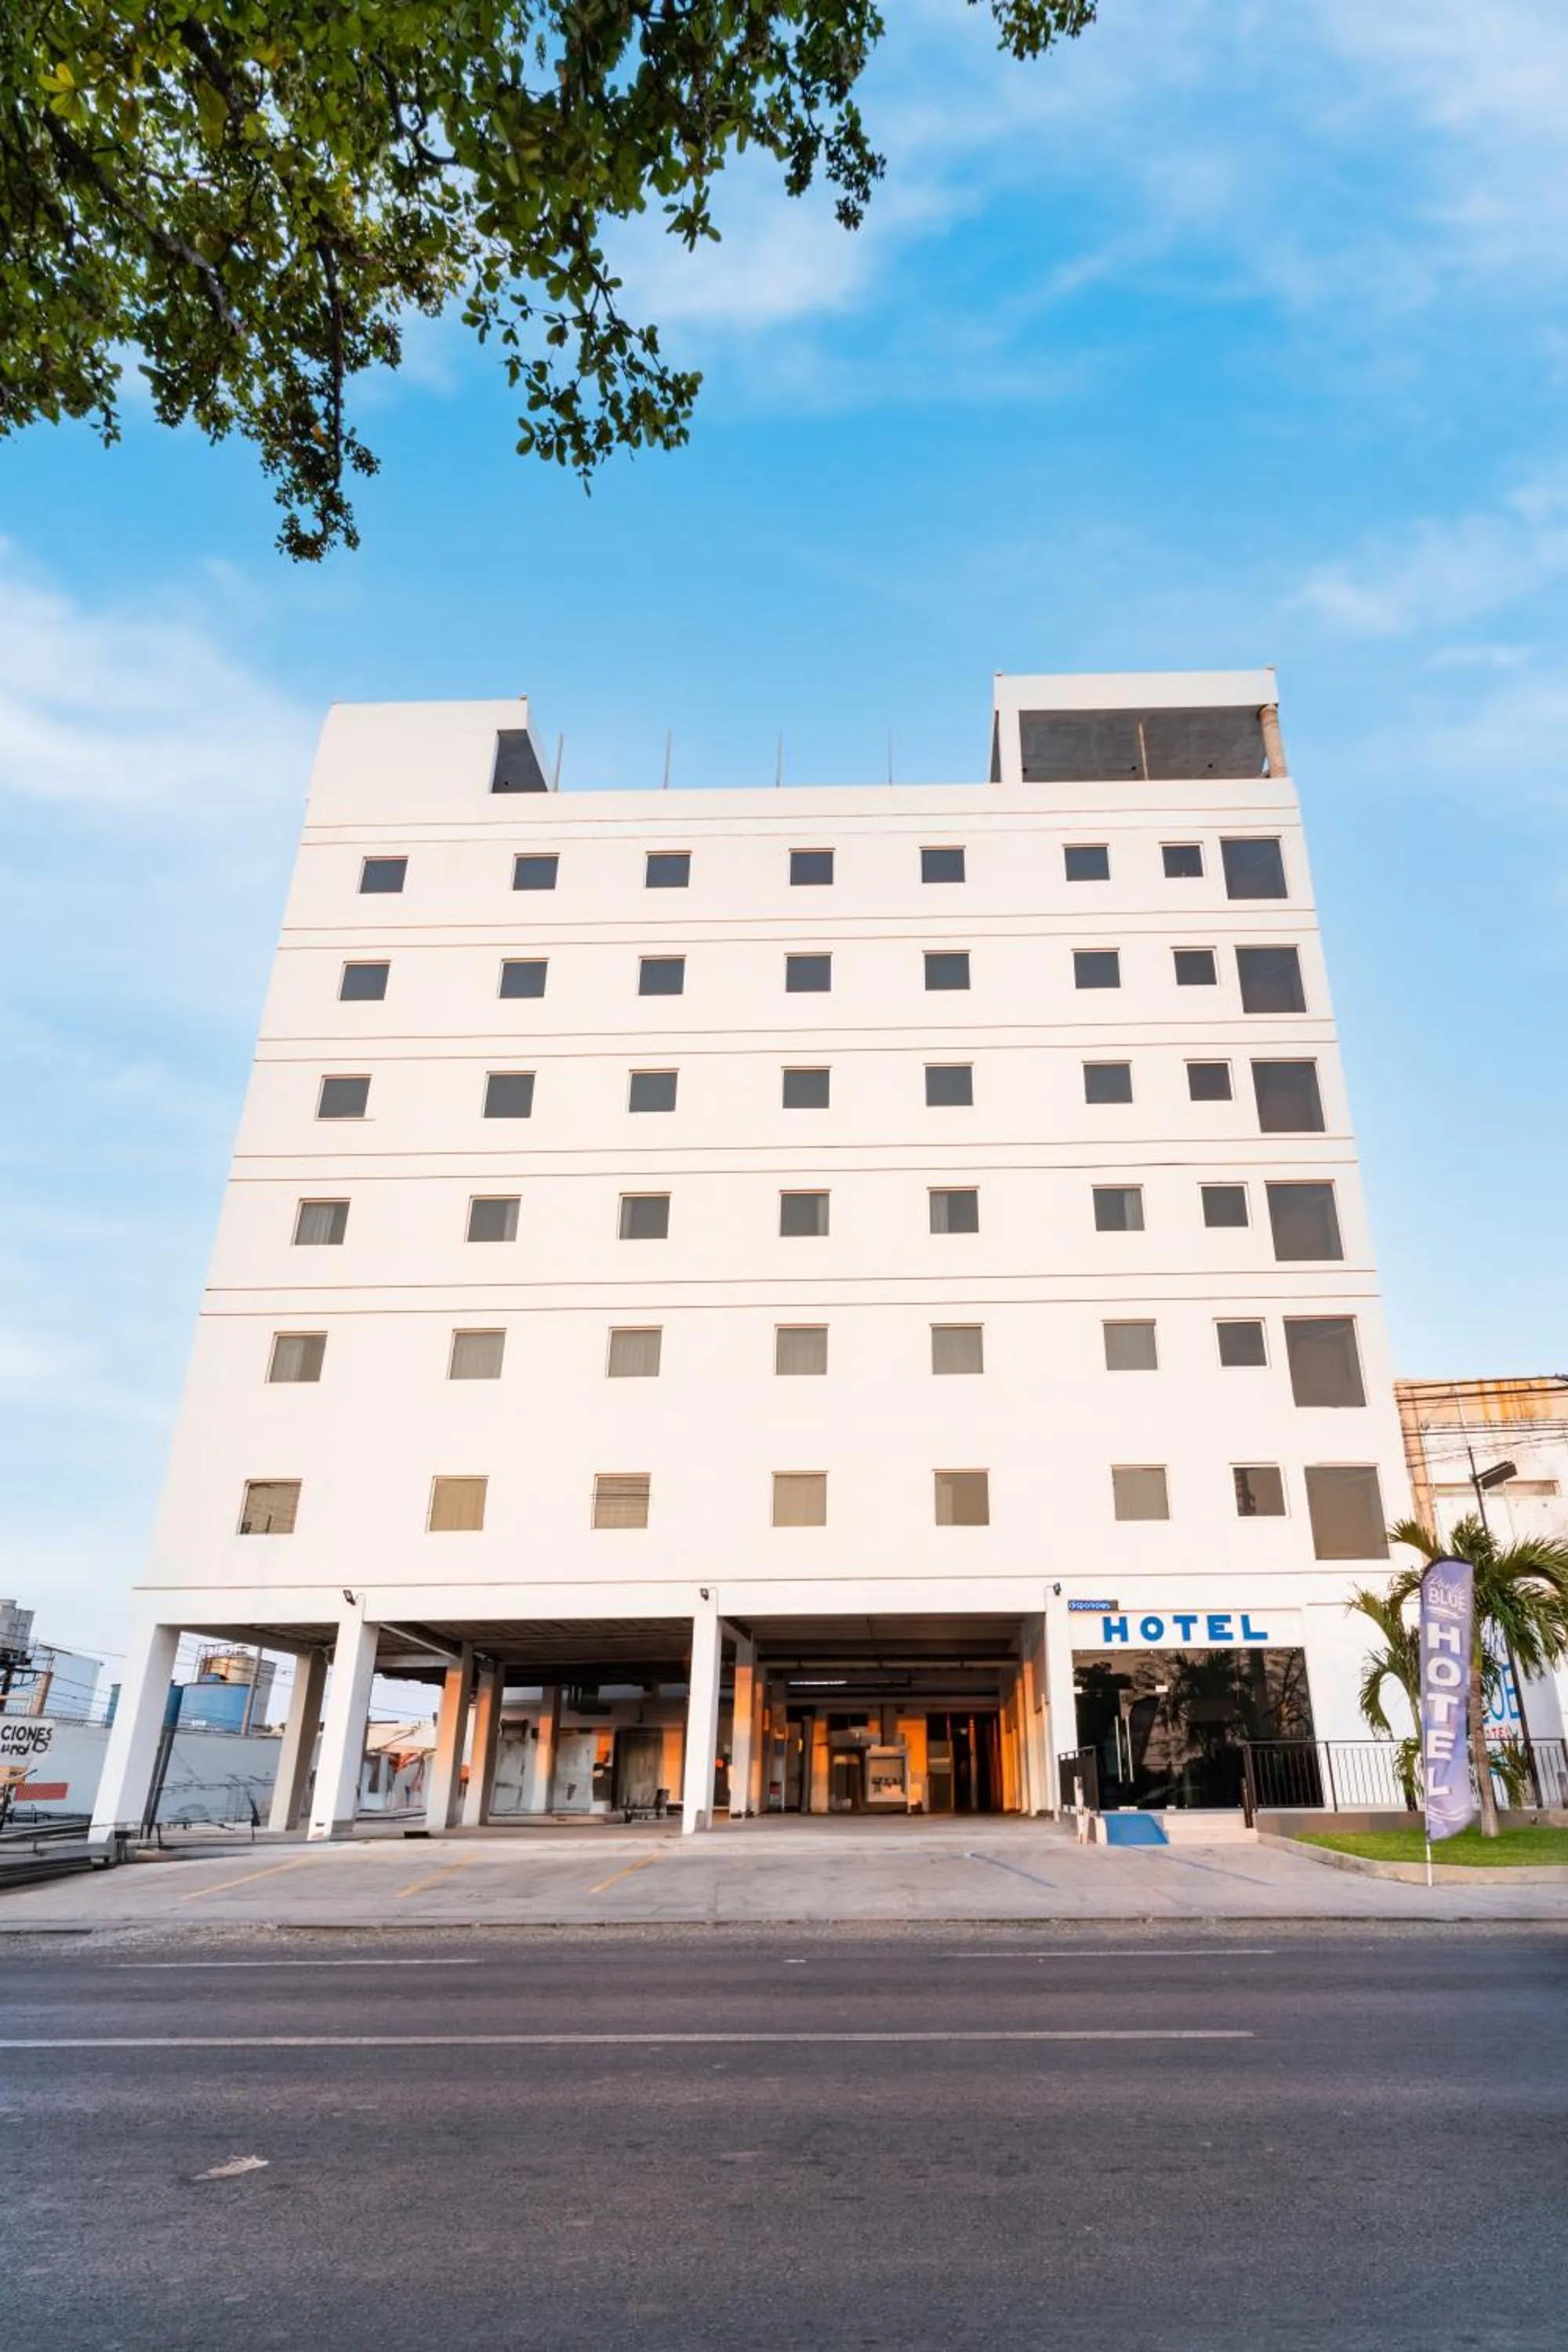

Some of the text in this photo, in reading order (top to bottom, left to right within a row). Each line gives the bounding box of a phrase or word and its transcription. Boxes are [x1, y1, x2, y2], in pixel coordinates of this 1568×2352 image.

[1428, 1586, 1467, 1613] BLUE
[1102, 1613, 1269, 1643] HOTEL
[1427, 1621, 1461, 1798] HOTEL
[1, 1724, 53, 1741] CIONES
